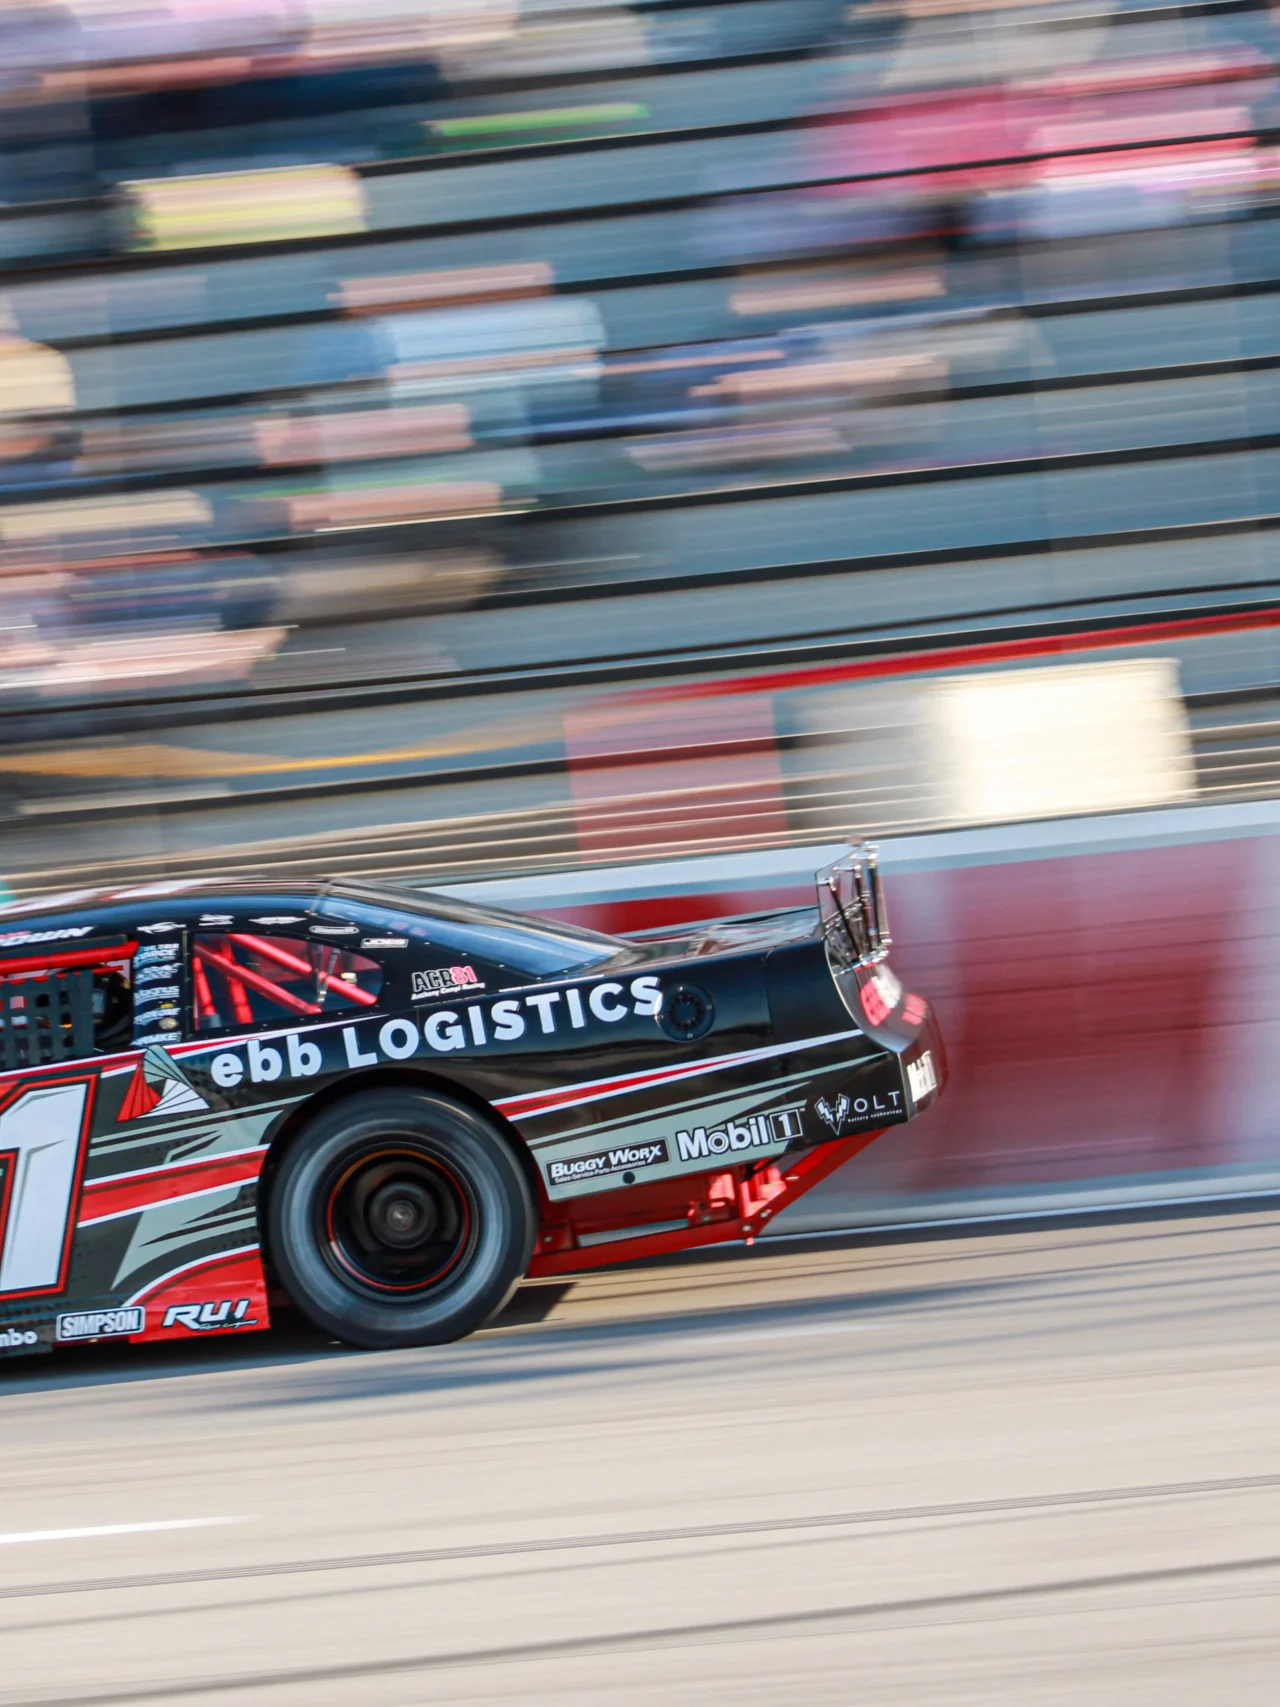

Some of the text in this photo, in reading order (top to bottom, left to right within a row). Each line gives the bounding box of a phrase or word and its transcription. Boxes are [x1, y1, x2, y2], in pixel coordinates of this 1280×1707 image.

[210, 976, 662, 1089] ebb LOGISTICS
[675, 1114, 770, 1162] Mobil
[551, 1157, 607, 1179] BUGGY
[61, 1309, 139, 1338] SIMPSON
